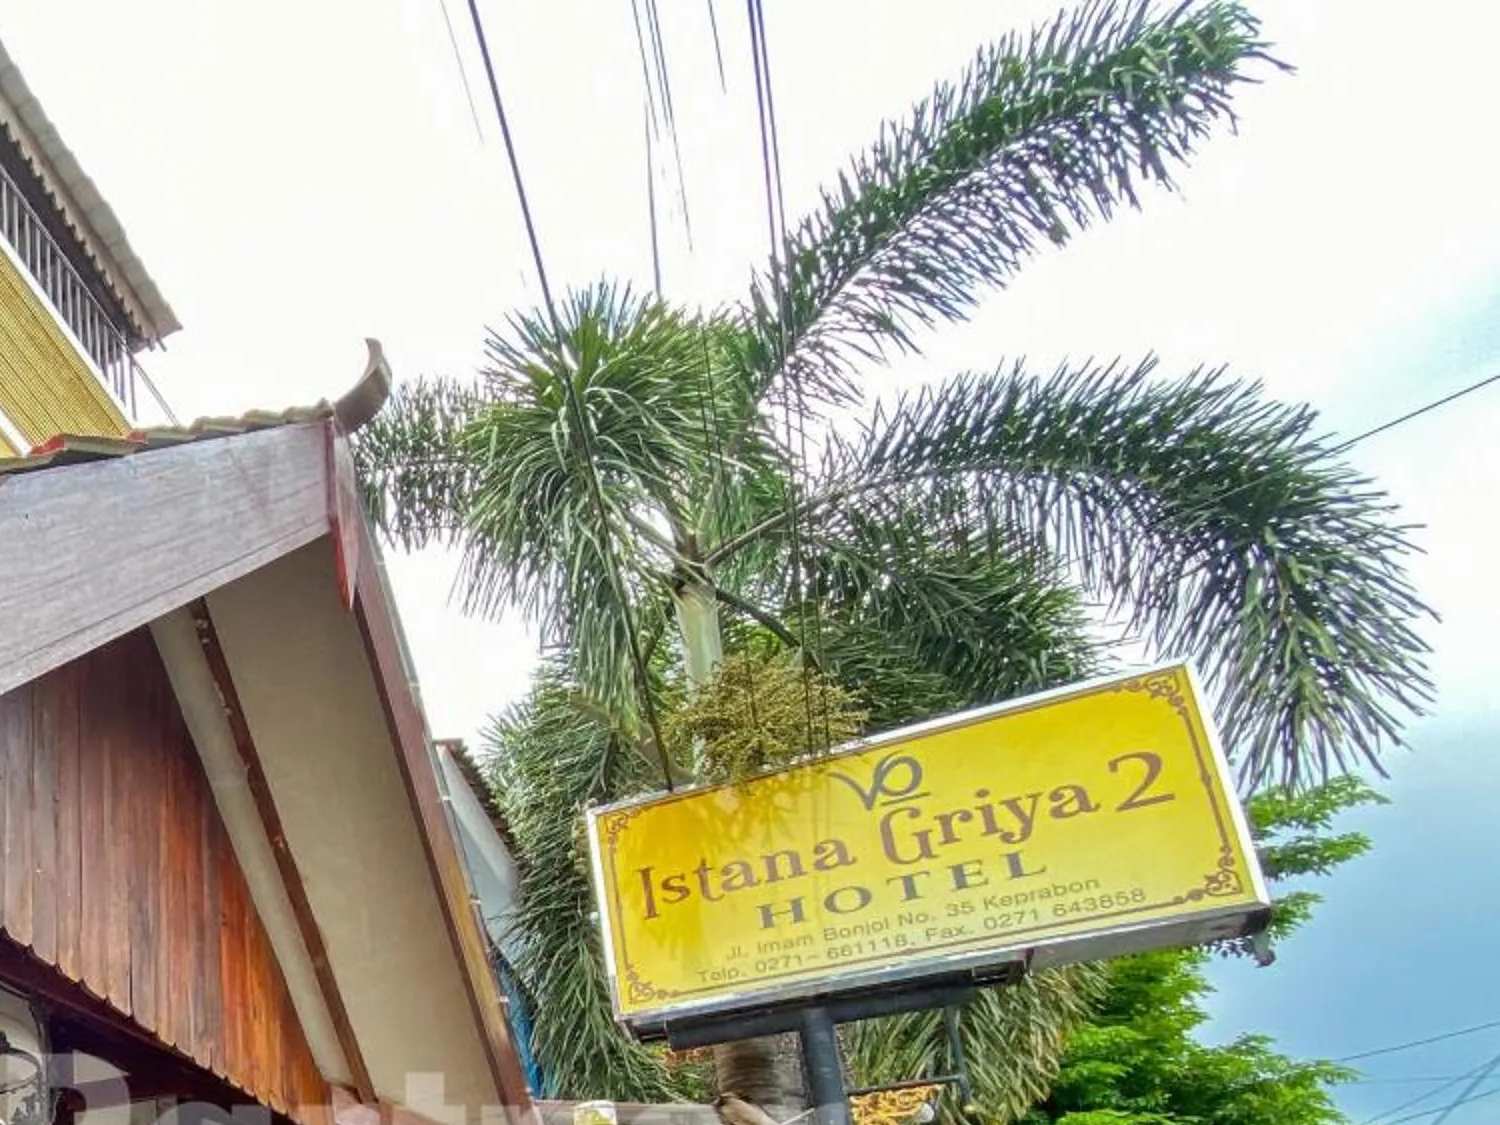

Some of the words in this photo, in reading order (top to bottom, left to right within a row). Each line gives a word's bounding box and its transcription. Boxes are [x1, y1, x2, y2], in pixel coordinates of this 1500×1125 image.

[636, 838, 857, 921] Istana
[880, 783, 1100, 866] Griya
[1108, 752, 1176, 812] 2
[756, 851, 1047, 929] HOTEL
[757, 933, 814, 953] Imam
[823, 918, 891, 943] Bonjol
[899, 911, 937, 928] No.
[947, 901, 975, 917] 35
[984, 878, 1100, 911] Keprabon
[984, 908, 1040, 930] 0271
[1052, 888, 1147, 918] 643858
